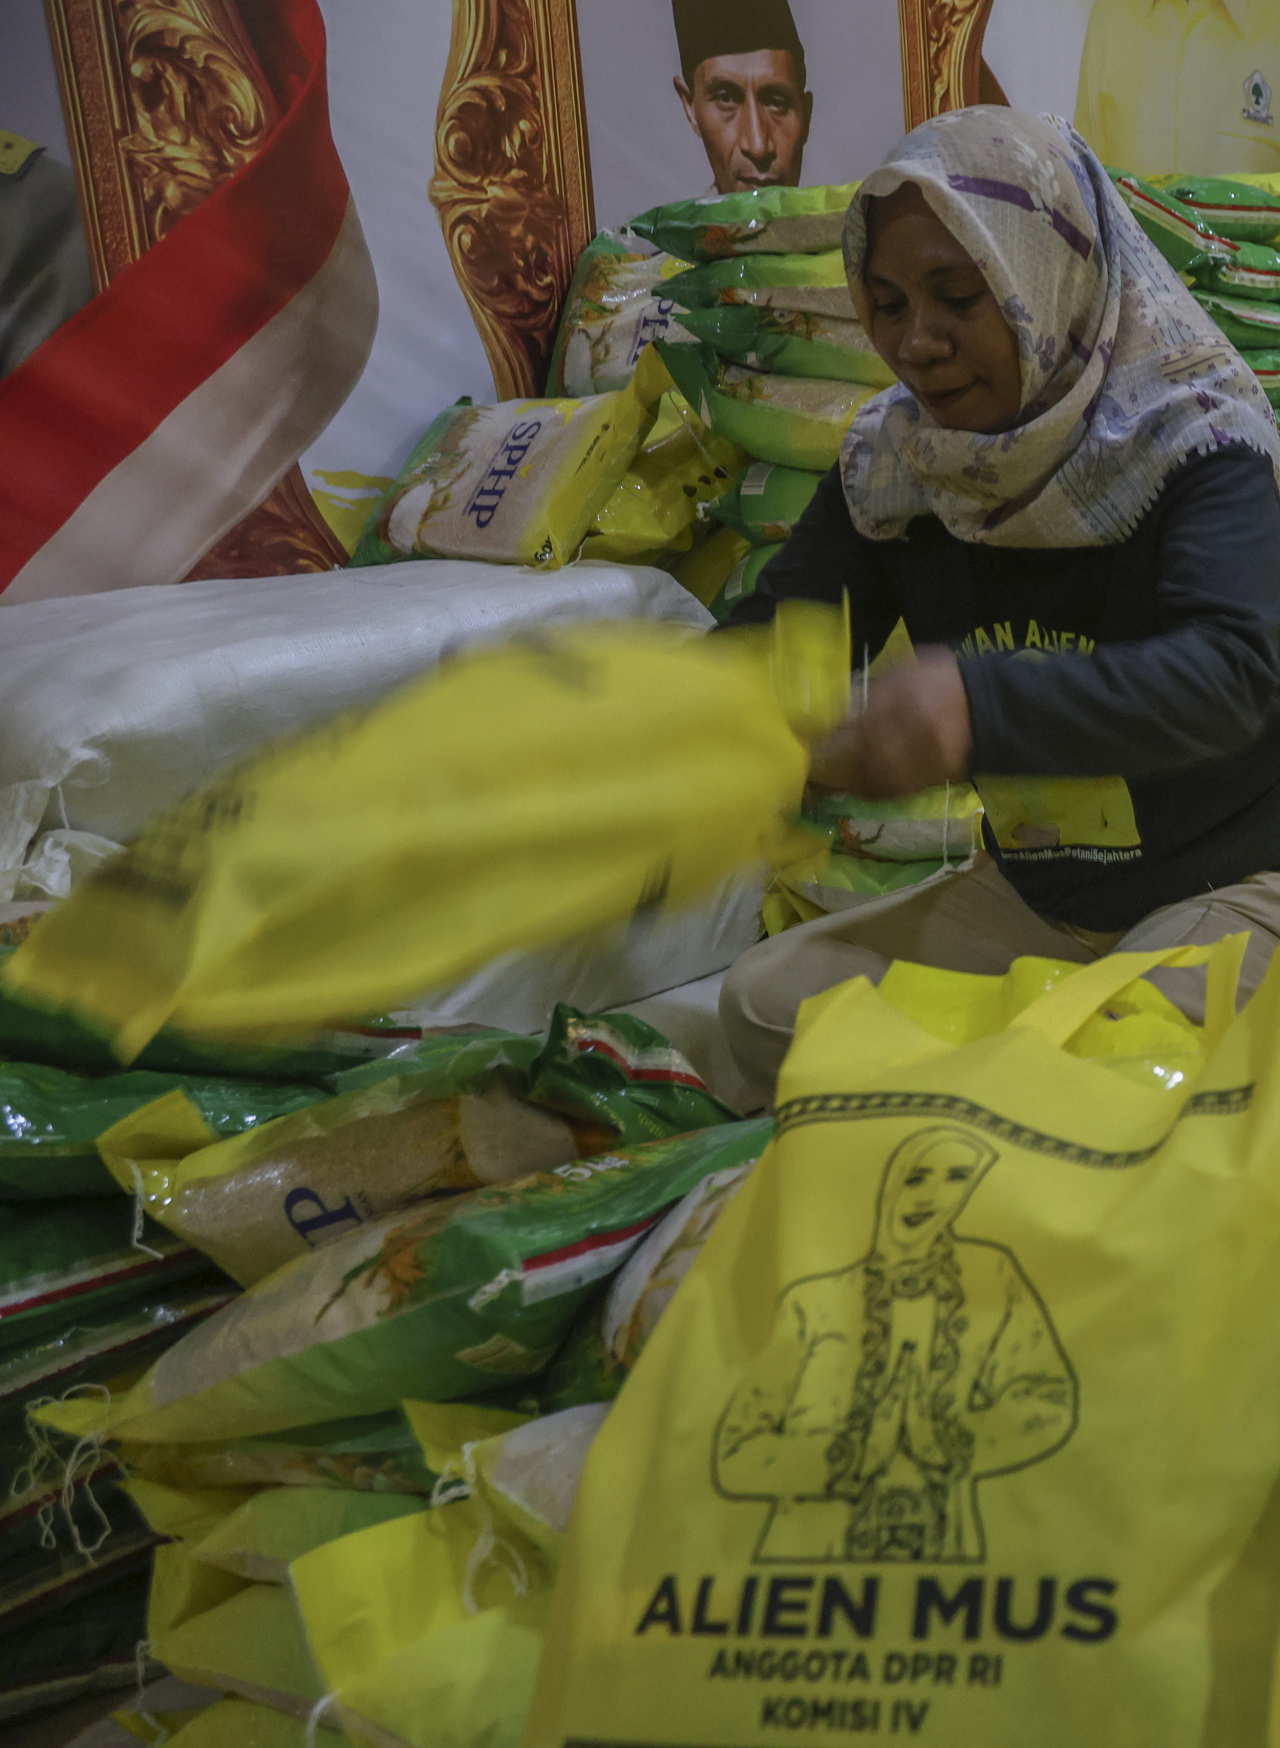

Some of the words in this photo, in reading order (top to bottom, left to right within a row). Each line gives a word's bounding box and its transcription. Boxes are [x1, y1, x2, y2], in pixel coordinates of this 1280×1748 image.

[467, 421, 542, 529] SPHP
[1024, 618, 1096, 657] ALIEN
[633, 1575, 882, 1640] ALIEN
[912, 1576, 1120, 1645] MUS
[708, 1648, 872, 1684] ANGGOTA
[882, 1651, 958, 1687] DPR
[967, 1652, 1004, 1687] RI
[759, 1696, 881, 1733] KOMISI
[890, 1699, 930, 1735] IV
